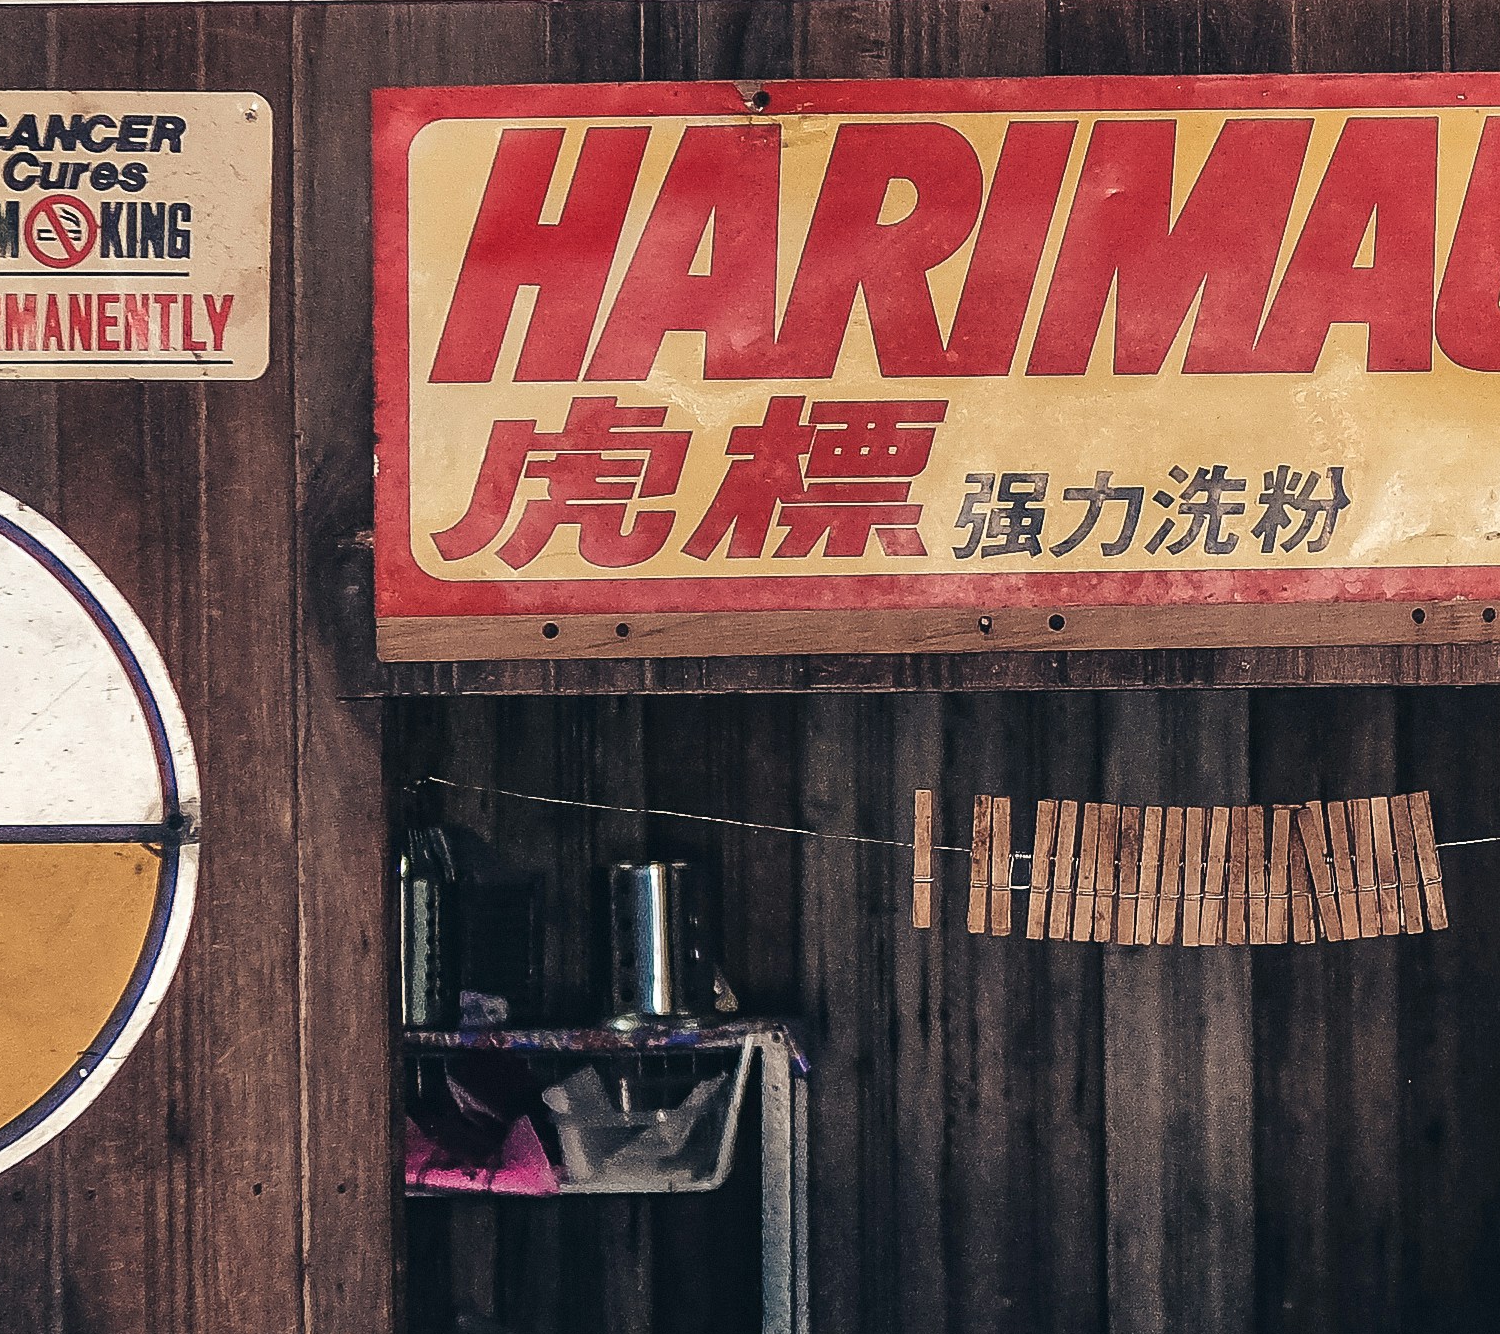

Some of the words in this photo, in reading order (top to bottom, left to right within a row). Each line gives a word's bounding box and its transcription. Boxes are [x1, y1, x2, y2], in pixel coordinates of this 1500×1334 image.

[2, 152, 149, 192] Cures
[429, 394, 949, 571] 虎標
[952, 462, 1353, 560] 强力洗粉
